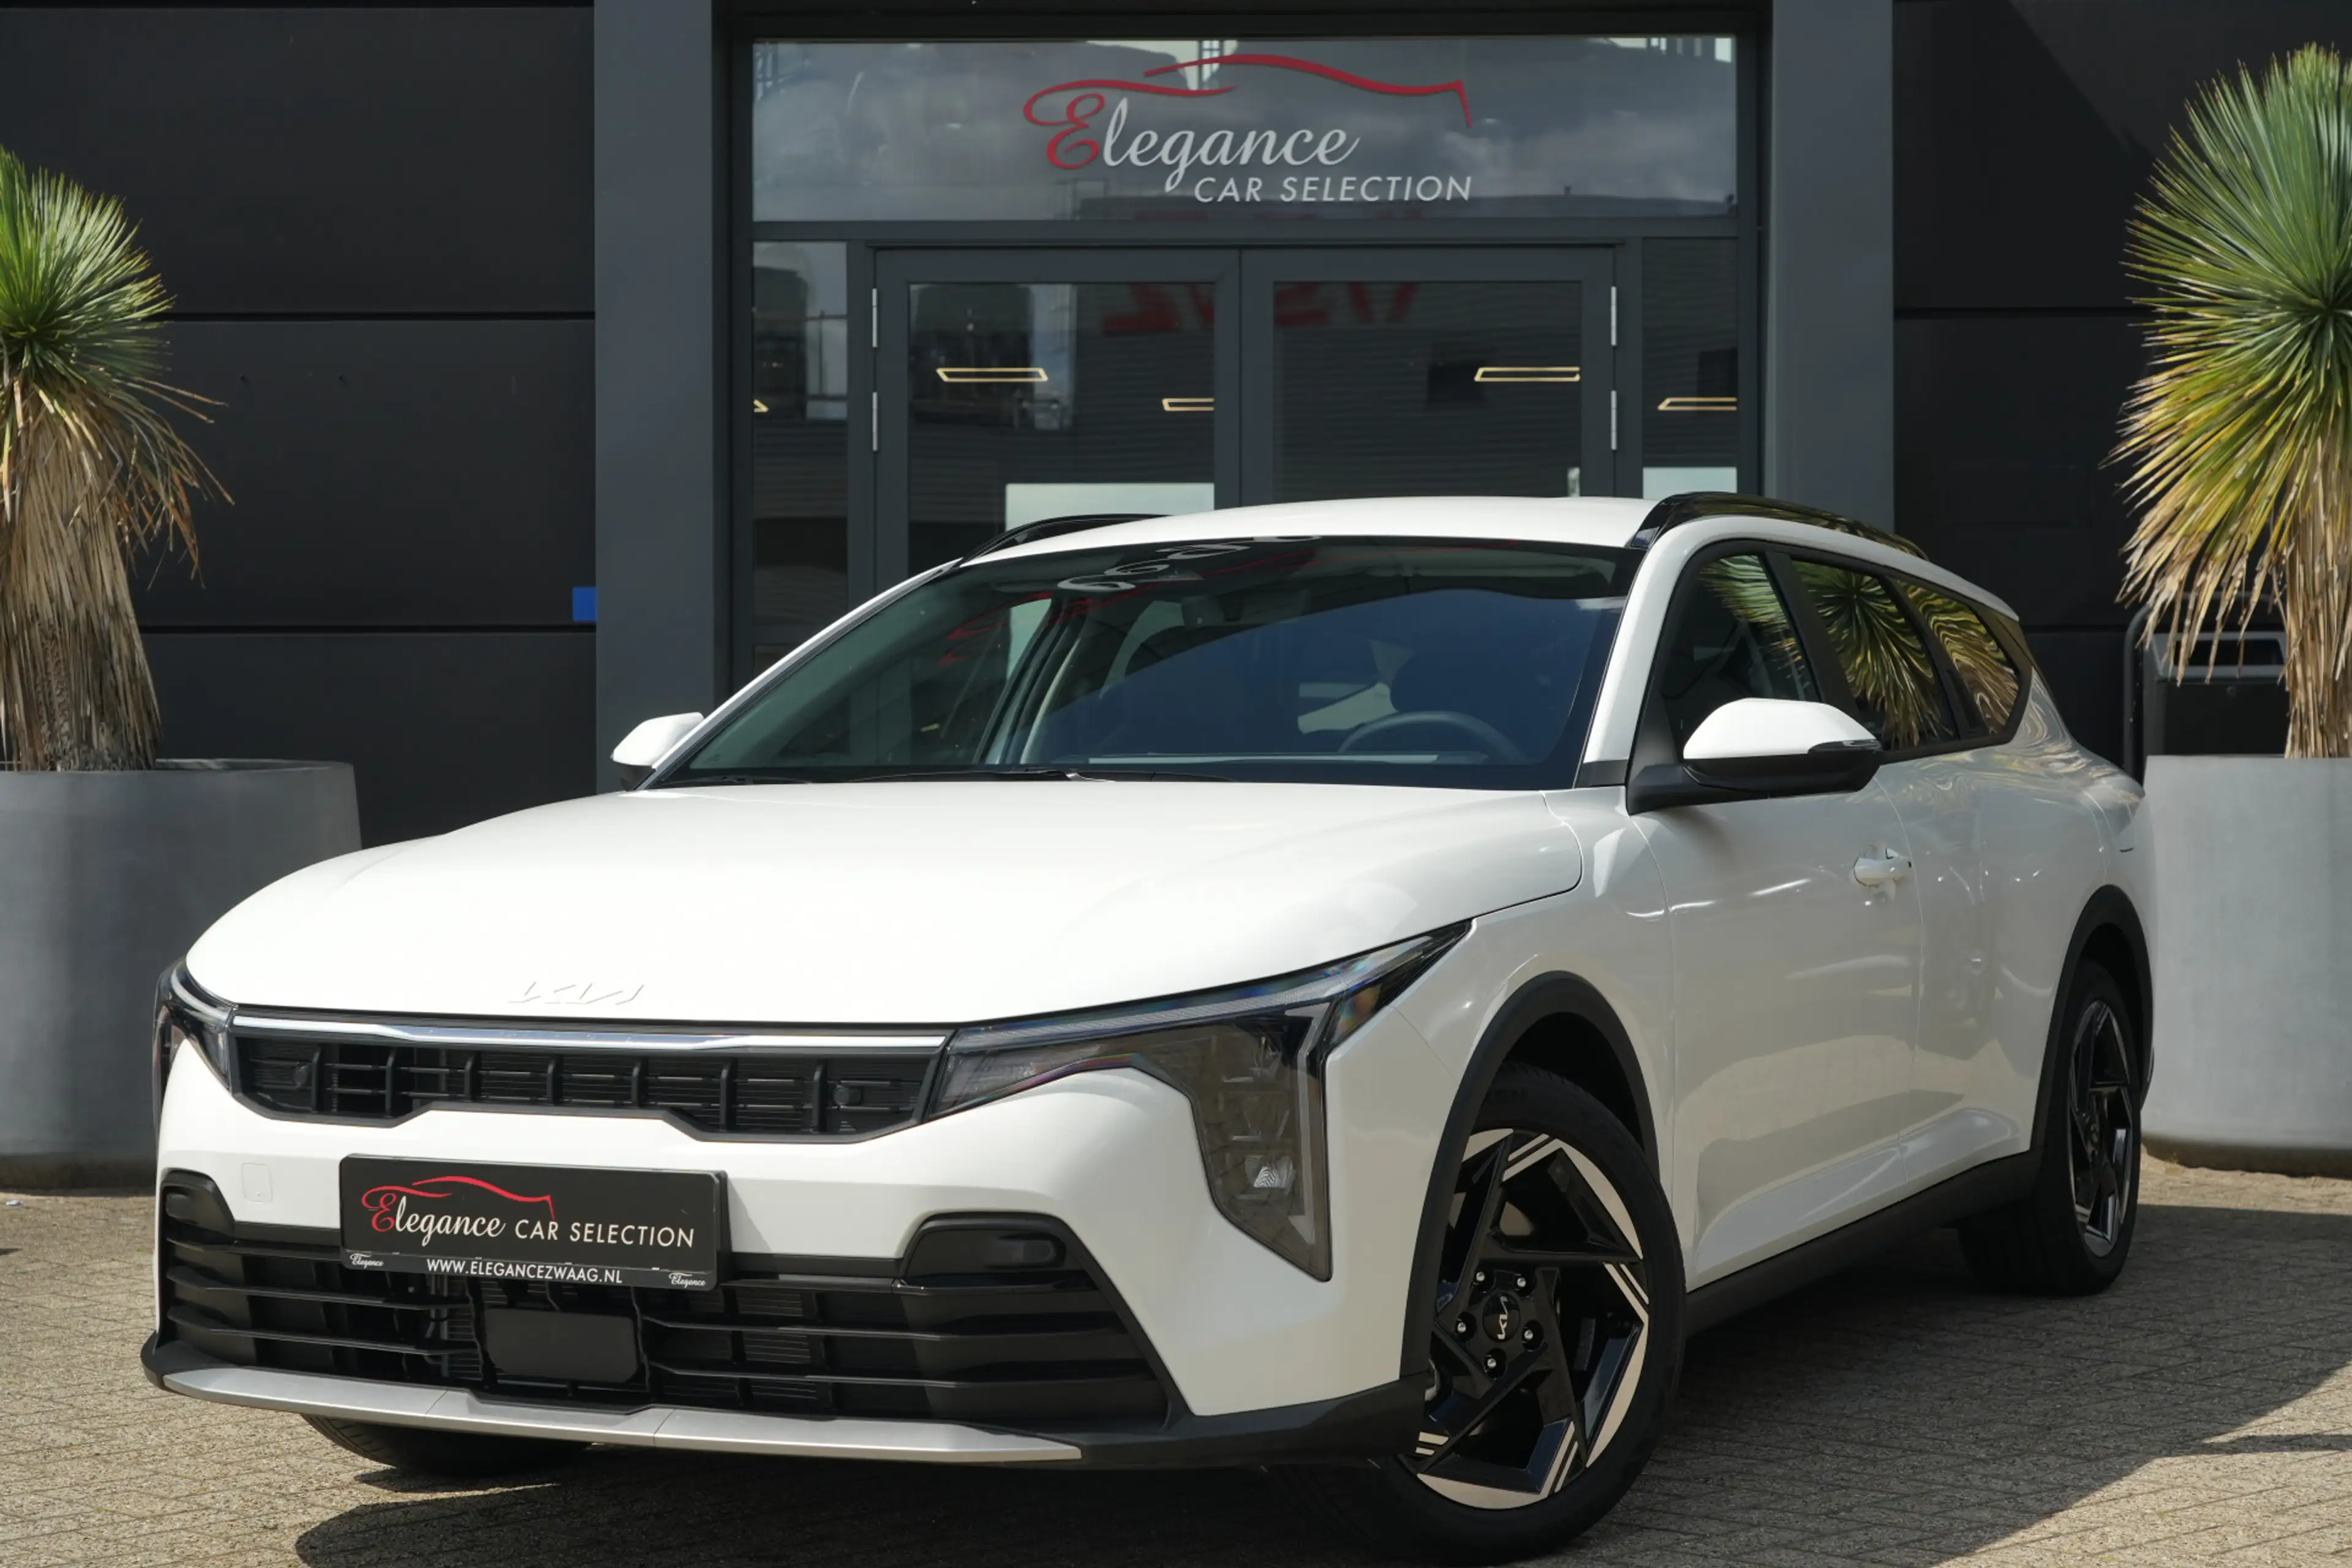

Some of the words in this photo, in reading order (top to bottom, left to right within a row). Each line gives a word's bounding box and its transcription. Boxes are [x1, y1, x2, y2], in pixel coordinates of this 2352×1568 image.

[1023, 80, 1360, 194] Elegance
[1194, 176, 1263, 203] CAR
[1280, 175, 1472, 203] SELECTION
[361, 1186, 507, 1247] Elegance
[514, 1219, 559, 1241] CAR
[570, 1222, 695, 1248] SELECTION
[350, 1253, 385, 1269] Elegance
[426, 1257, 623, 1285] WWW.ELEGANCEZWAAG.NL
[668, 1272, 706, 1289] Elegance
